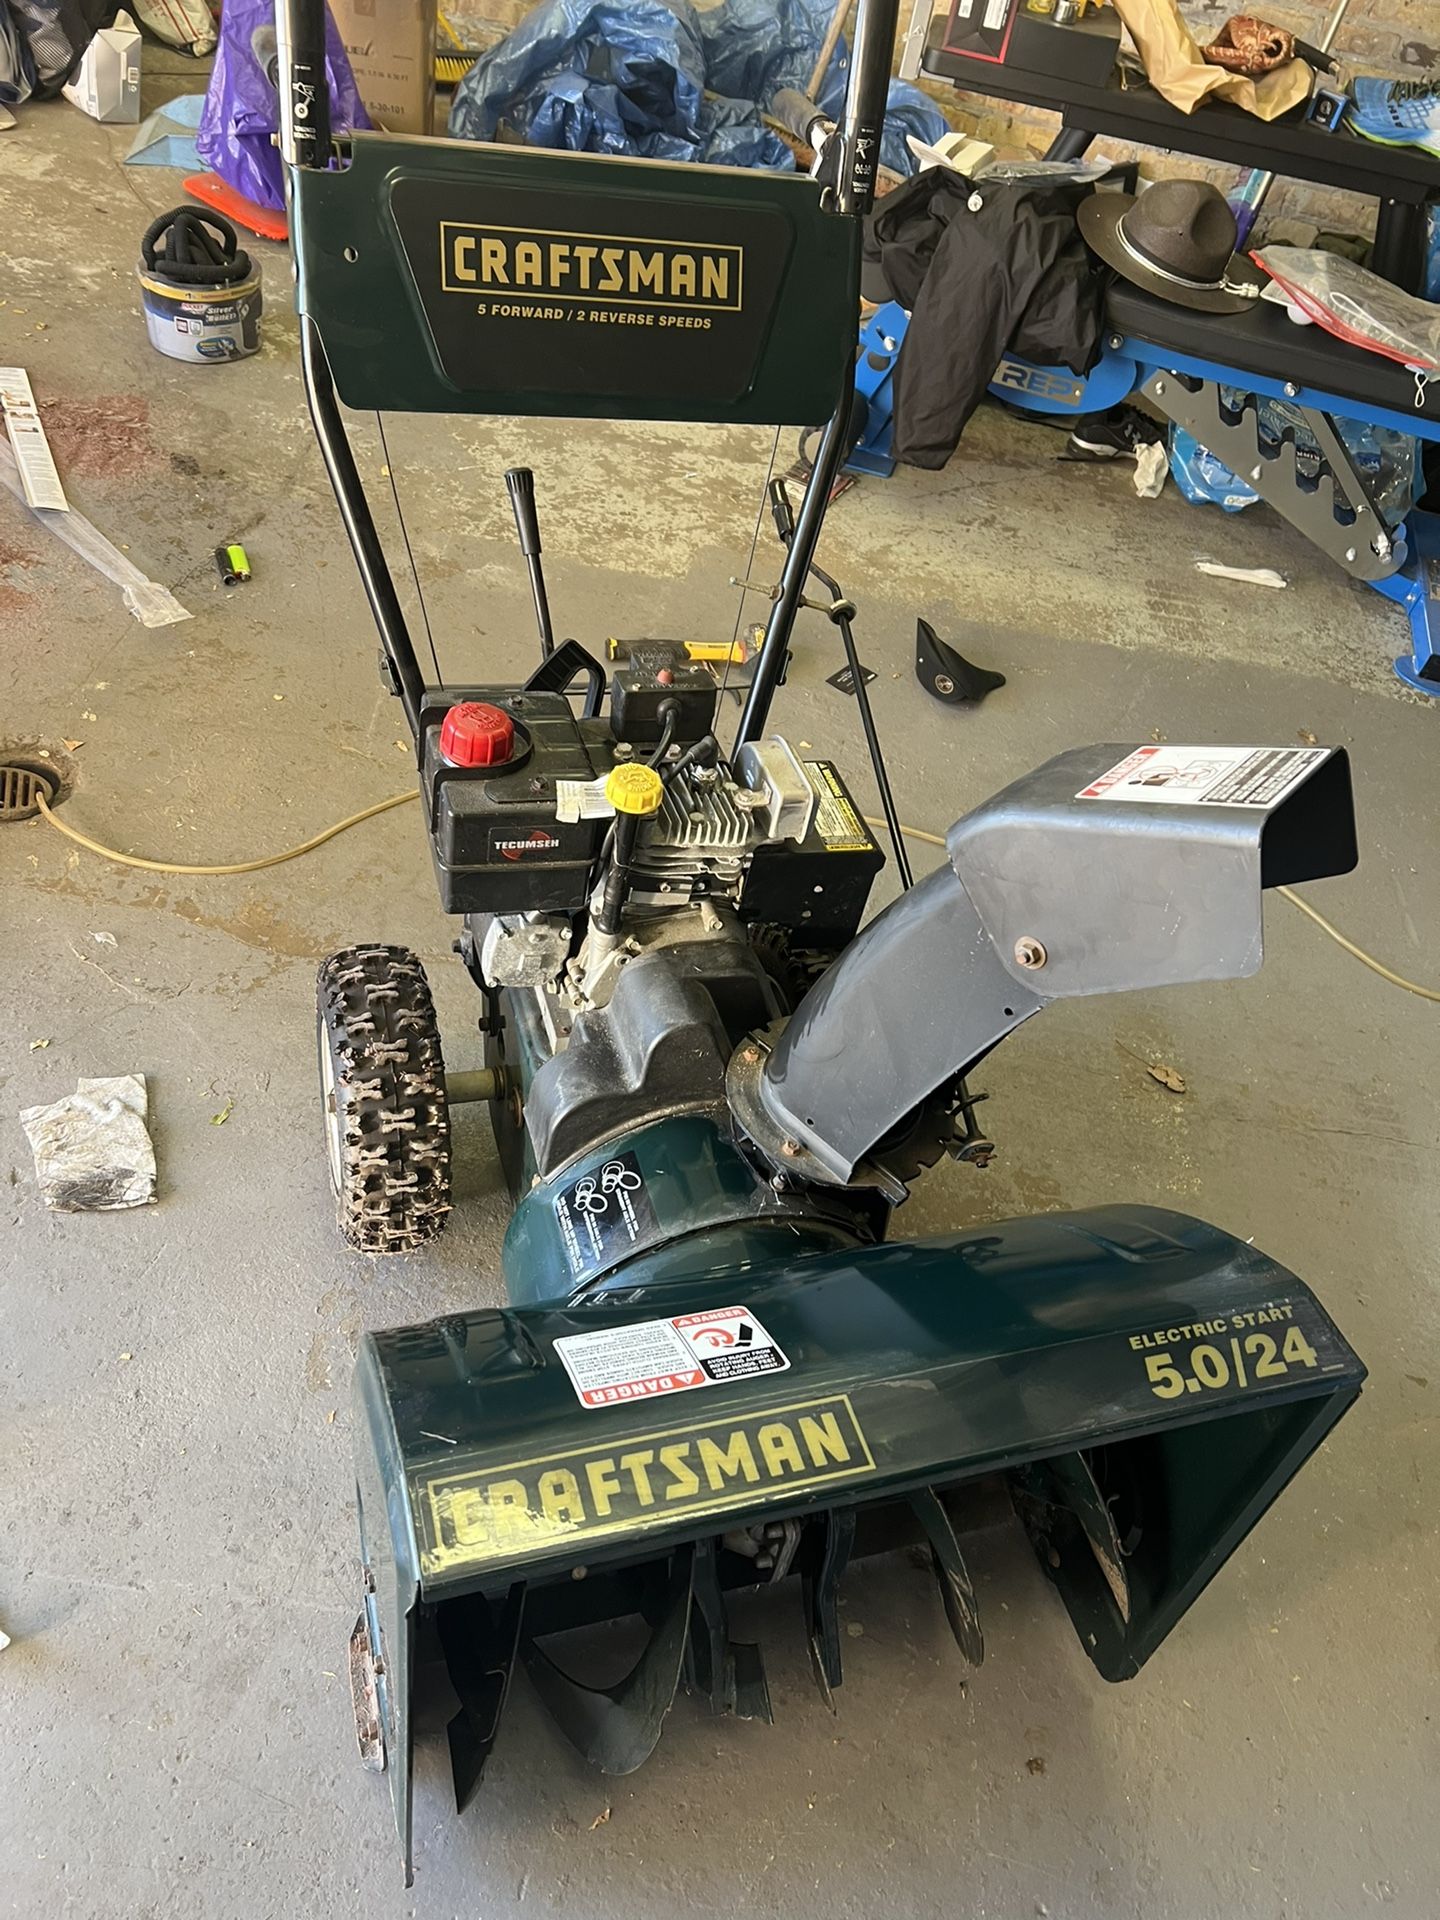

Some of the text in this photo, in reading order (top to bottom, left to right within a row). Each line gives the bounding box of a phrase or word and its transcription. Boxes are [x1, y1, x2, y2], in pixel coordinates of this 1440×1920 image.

[454, 236, 728, 299] CRAFTSMAN
[207, 306, 234, 314] Silver
[477, 303, 712, 328] 5 FORWARD / 2 REVERSE SPEEDS
[1001, 364, 1073, 395] REP
[494, 839, 560, 850] TECUMSEH
[692, 1309, 743, 1324] DANGER
[1129, 1305, 1293, 1350] ELECTRIC START
[1144, 1326, 1318, 1398] 5.0/24
[591, 1377, 674, 1404] DANGER
[450, 1412, 851, 1546] CRAFTSMAN
